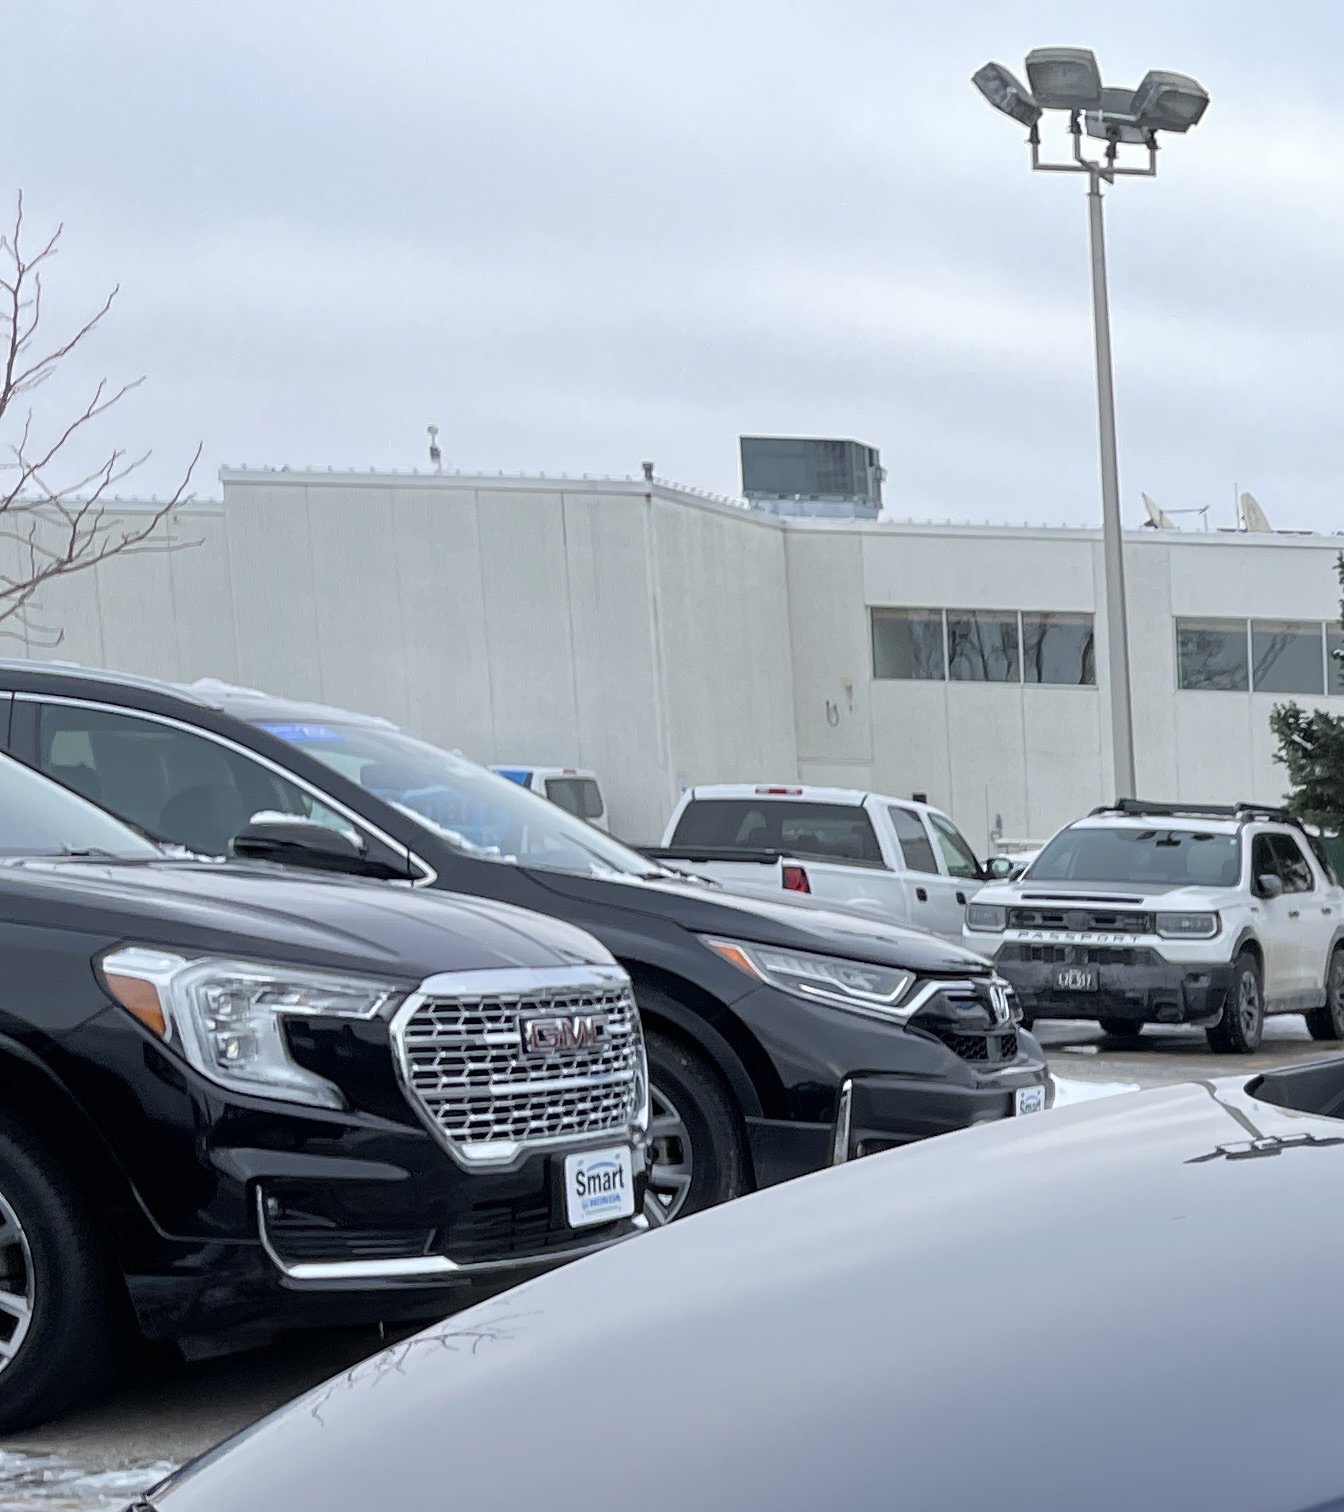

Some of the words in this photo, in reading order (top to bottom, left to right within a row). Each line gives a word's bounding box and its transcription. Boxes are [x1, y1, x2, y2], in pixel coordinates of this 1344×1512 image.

[1018, 930, 1141, 943] PASSPORT
[525, 1016, 609, 1050] GMC
[575, 1163, 624, 1197] Smart
